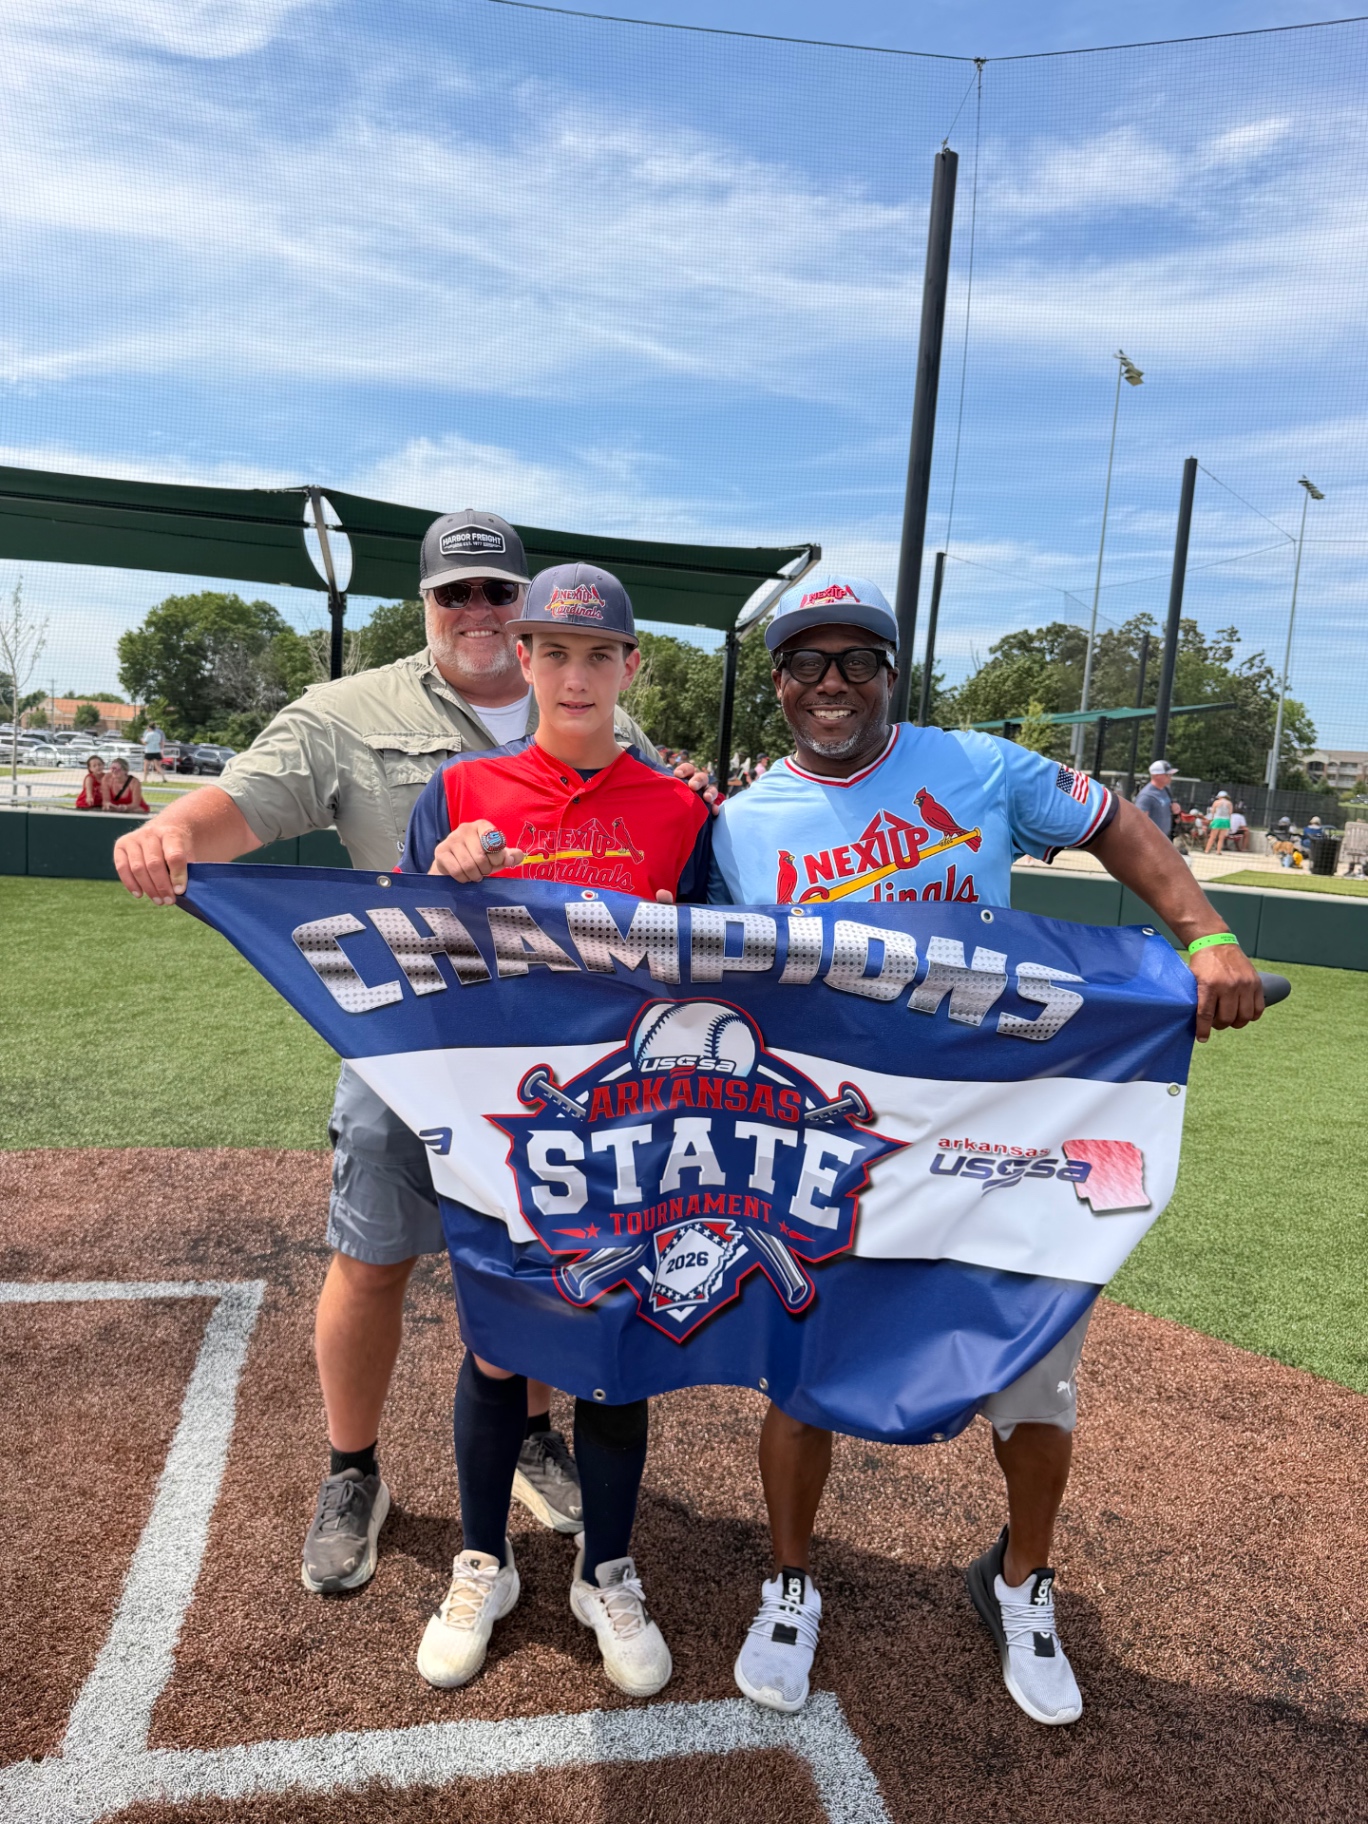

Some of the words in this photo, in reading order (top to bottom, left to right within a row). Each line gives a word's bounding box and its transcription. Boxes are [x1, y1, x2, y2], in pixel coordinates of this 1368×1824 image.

[443, 533, 471, 546] HARBOR
[472, 532, 502, 545] FREIGHT
[292, 902, 1085, 1041] CHAMPIONS
[588, 1076, 802, 1123] ARKANSAS
[938, 1138, 1050, 1158] arkansas
[527, 1117, 866, 1230] STATE
[610, 1193, 772, 1236] TOURNAMENT
[666, 1251, 708, 1275] 2026
